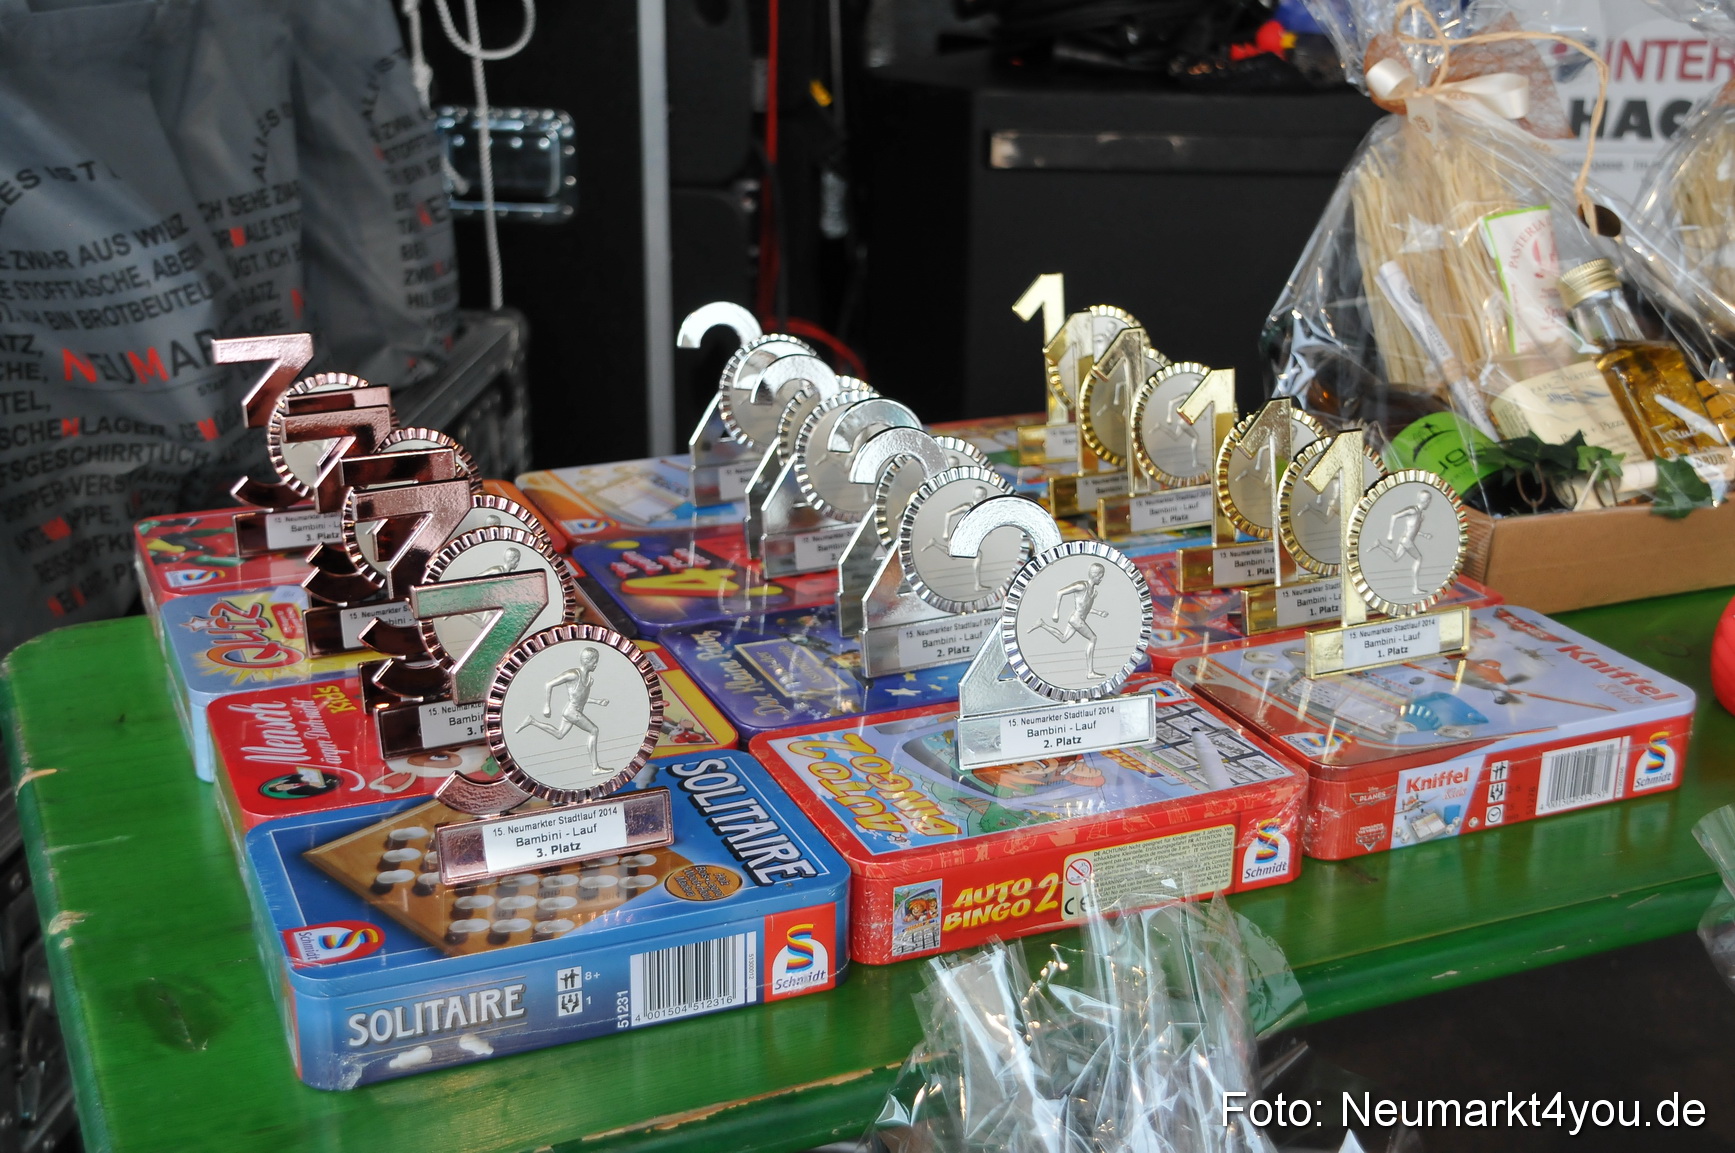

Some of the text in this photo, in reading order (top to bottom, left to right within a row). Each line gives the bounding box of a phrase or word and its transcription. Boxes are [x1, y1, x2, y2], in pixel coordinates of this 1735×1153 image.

[9, 233, 132, 270] ZWAR AUS
[1149, 506, 1178, 516] Bambini
[291, 522, 326, 532] Bambini
[317, 531, 340, 540] Platz
[1234, 557, 1265, 568] Bambini
[1291, 585, 1323, 597] Neumarkter
[1296, 596, 1328, 607] Bambini
[1309, 603, 1340, 616] 1. Platz
[349, 607, 402, 620] 15. Neumarkter
[905, 631, 914, 639] 15.
[916, 625, 953, 638] Neumarkter
[954, 619, 983, 631] Stadtlauf
[1359, 625, 1393, 638] Neumarkter
[1393, 620, 1420, 633] Stadtlauf
[1421, 618, 1436, 628] 2014
[922, 631, 984, 648] Bambini Lauf
[1364, 631, 1421, 649] Bambini Lauf
[936, 645, 971, 658] 2. Platz
[1377, 646, 1409, 658] 1. Platz
[1556, 645, 1679, 701] Kniffel
[312, 685, 357, 714] Kids
[428, 708, 439, 716] 15.
[1008, 705, 1116, 727] 15. Neumarkter Stadtlauf 2014
[228, 700, 313, 764] Mensch
[467, 727, 477, 736] 3.
[1026, 719, 1097, 739] Bambini Lauf
[1043, 735, 1082, 749] 2. Platz
[1405, 767, 1470, 794] Kniffel
[1633, 771, 1673, 788] Schmidt
[807, 762, 908, 833] AUTO
[492, 806, 618, 838] 15. Neumarkter Stadtlauf 2014
[666, 758, 819, 888] SOLITAIRE
[516, 823, 599, 848] Bambini Lauf
[536, 841, 582, 859] 3. Platz
[1102, 846, 1128, 856] ACHTUNG!
[1243, 861, 1288, 880] Schmidt
[941, 872, 1060, 932] BINGO 2
[950, 877, 1033, 909] AUTO
[585, 971, 601, 981] 8+
[349, 983, 527, 1048] SOLITAIRE
[616, 989, 630, 1029] 51231
[647, 1005, 688, 1020] 001504
[693, 995, 733, 1011] 512316
